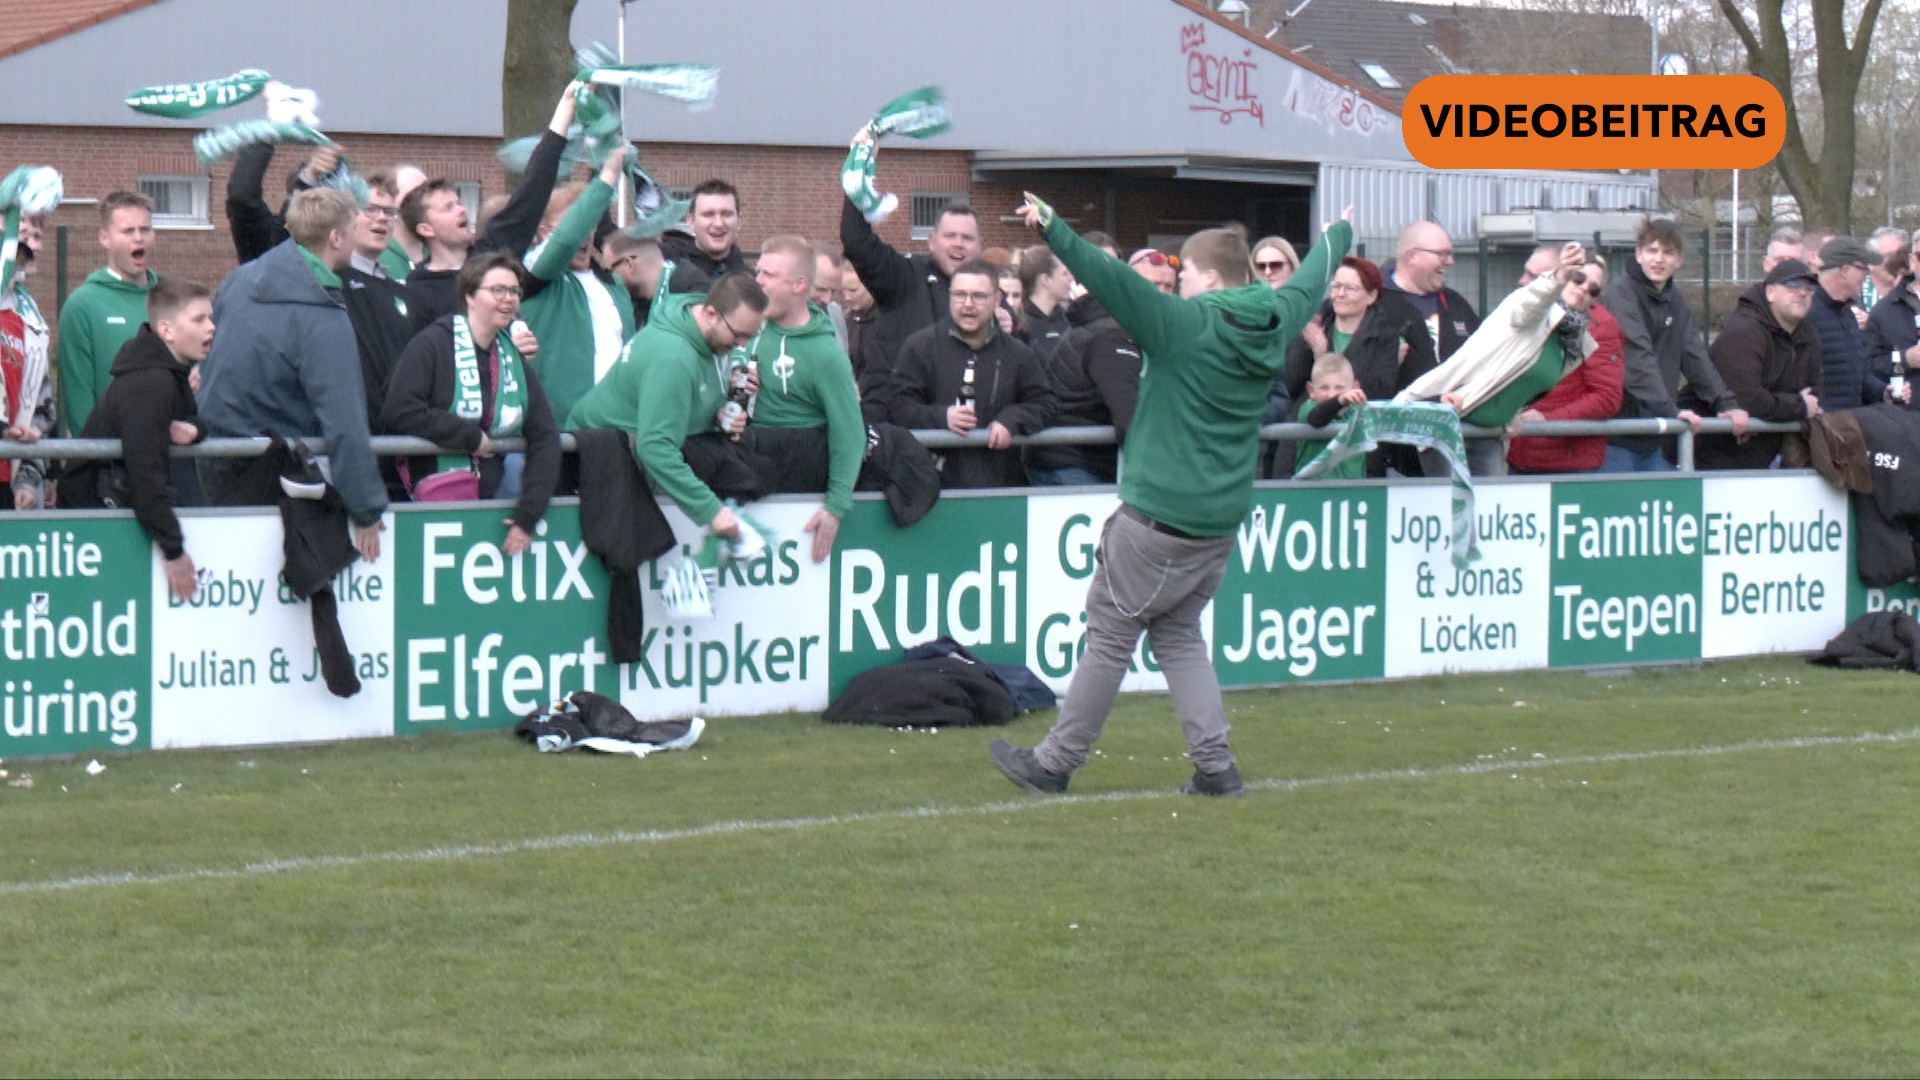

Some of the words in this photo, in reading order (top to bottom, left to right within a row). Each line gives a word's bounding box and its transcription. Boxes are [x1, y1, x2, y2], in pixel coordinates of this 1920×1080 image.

[1236, 500, 1368, 574] Wolli
[1391, 507, 1450, 552] Jop,
[1477, 503, 1546, 547] ukas,
[1557, 500, 1698, 560] Familie
[1703, 509, 1842, 556] Eierbude
[422, 519, 595, 606] Felix
[1416, 561, 1435, 598] &
[1446, 566, 1523, 597] Jonas
[1721, 572, 1825, 615] Bernte
[838, 541, 1019, 653] Rudi
[1554, 584, 1696, 652] Teepen
[628, 621, 820, 703] Küpker
[1222, 593, 1377, 677] Jager
[1419, 613, 1516, 654] Löcken
[160, 649, 256, 689] Julian
[269, 647, 290, 684] &
[302, 647, 389, 682] Jas
[407, 632, 607, 722] Elfert
